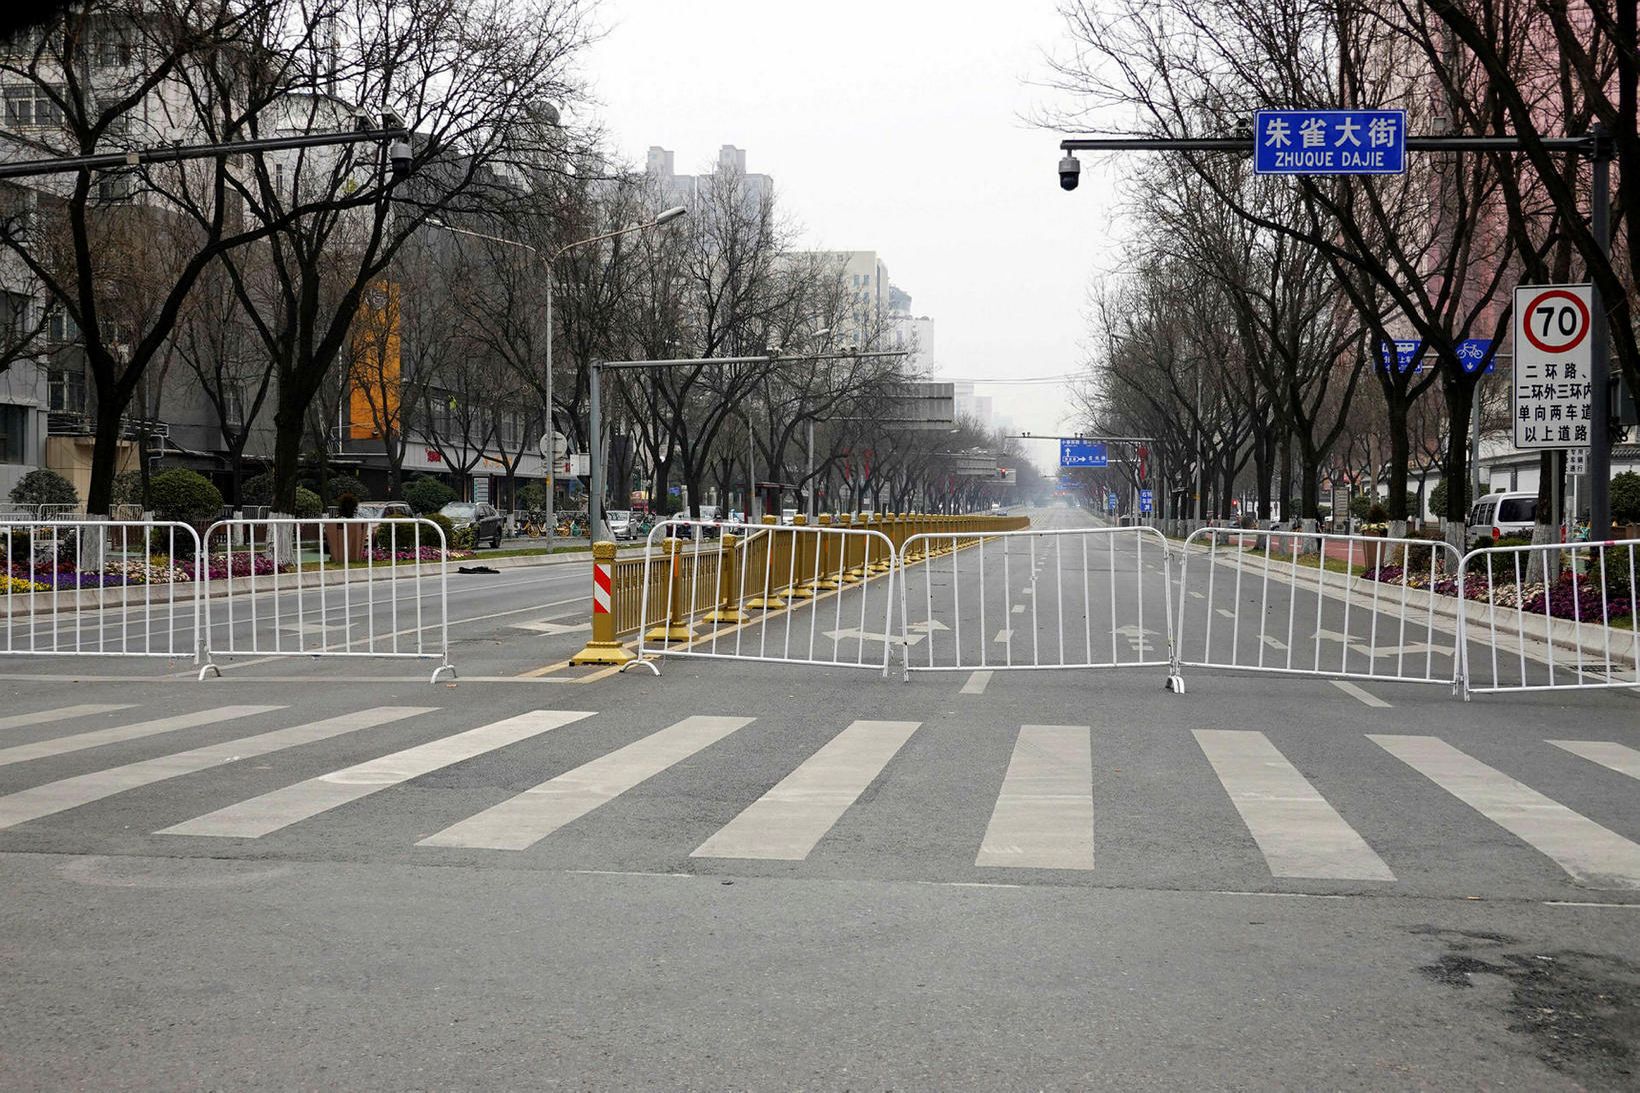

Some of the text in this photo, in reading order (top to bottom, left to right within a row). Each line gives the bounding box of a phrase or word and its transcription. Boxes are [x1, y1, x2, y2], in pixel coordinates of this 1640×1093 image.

[1265, 117, 1397, 149] 朱雀大街
[1275, 151, 1384, 167] ZHUQUE DAJIE
[1536, 306, 1577, 337] 70
[1525, 362, 1587, 380] 二环路、
[1518, 382, 1591, 401] 二环外三环内
[1518, 403, 1591, 422] 单向两车道
[1525, 424, 1588, 443] 以上道路
